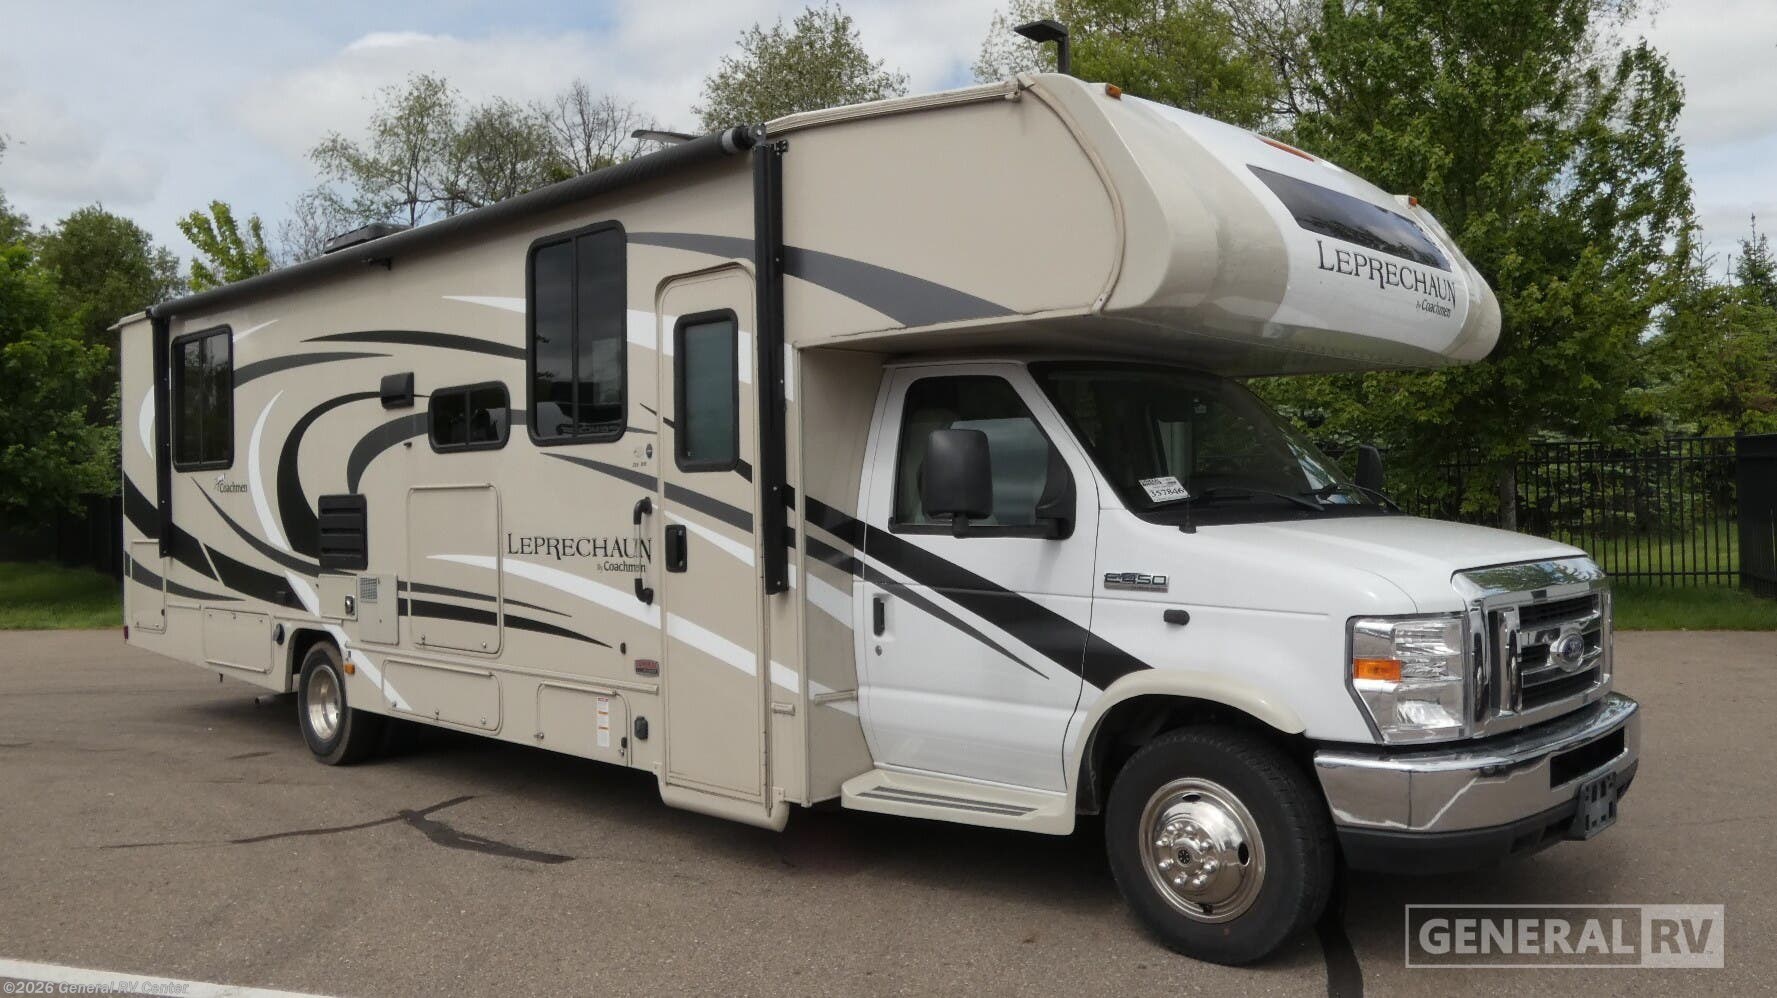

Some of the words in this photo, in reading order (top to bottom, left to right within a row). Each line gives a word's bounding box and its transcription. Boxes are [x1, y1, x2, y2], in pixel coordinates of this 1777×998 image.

[1316, 239, 1456, 309] LEPRECHAUN
[1421, 298, 1452, 319] Coachmen
[507, 532, 653, 565] LEPRECHAUN
